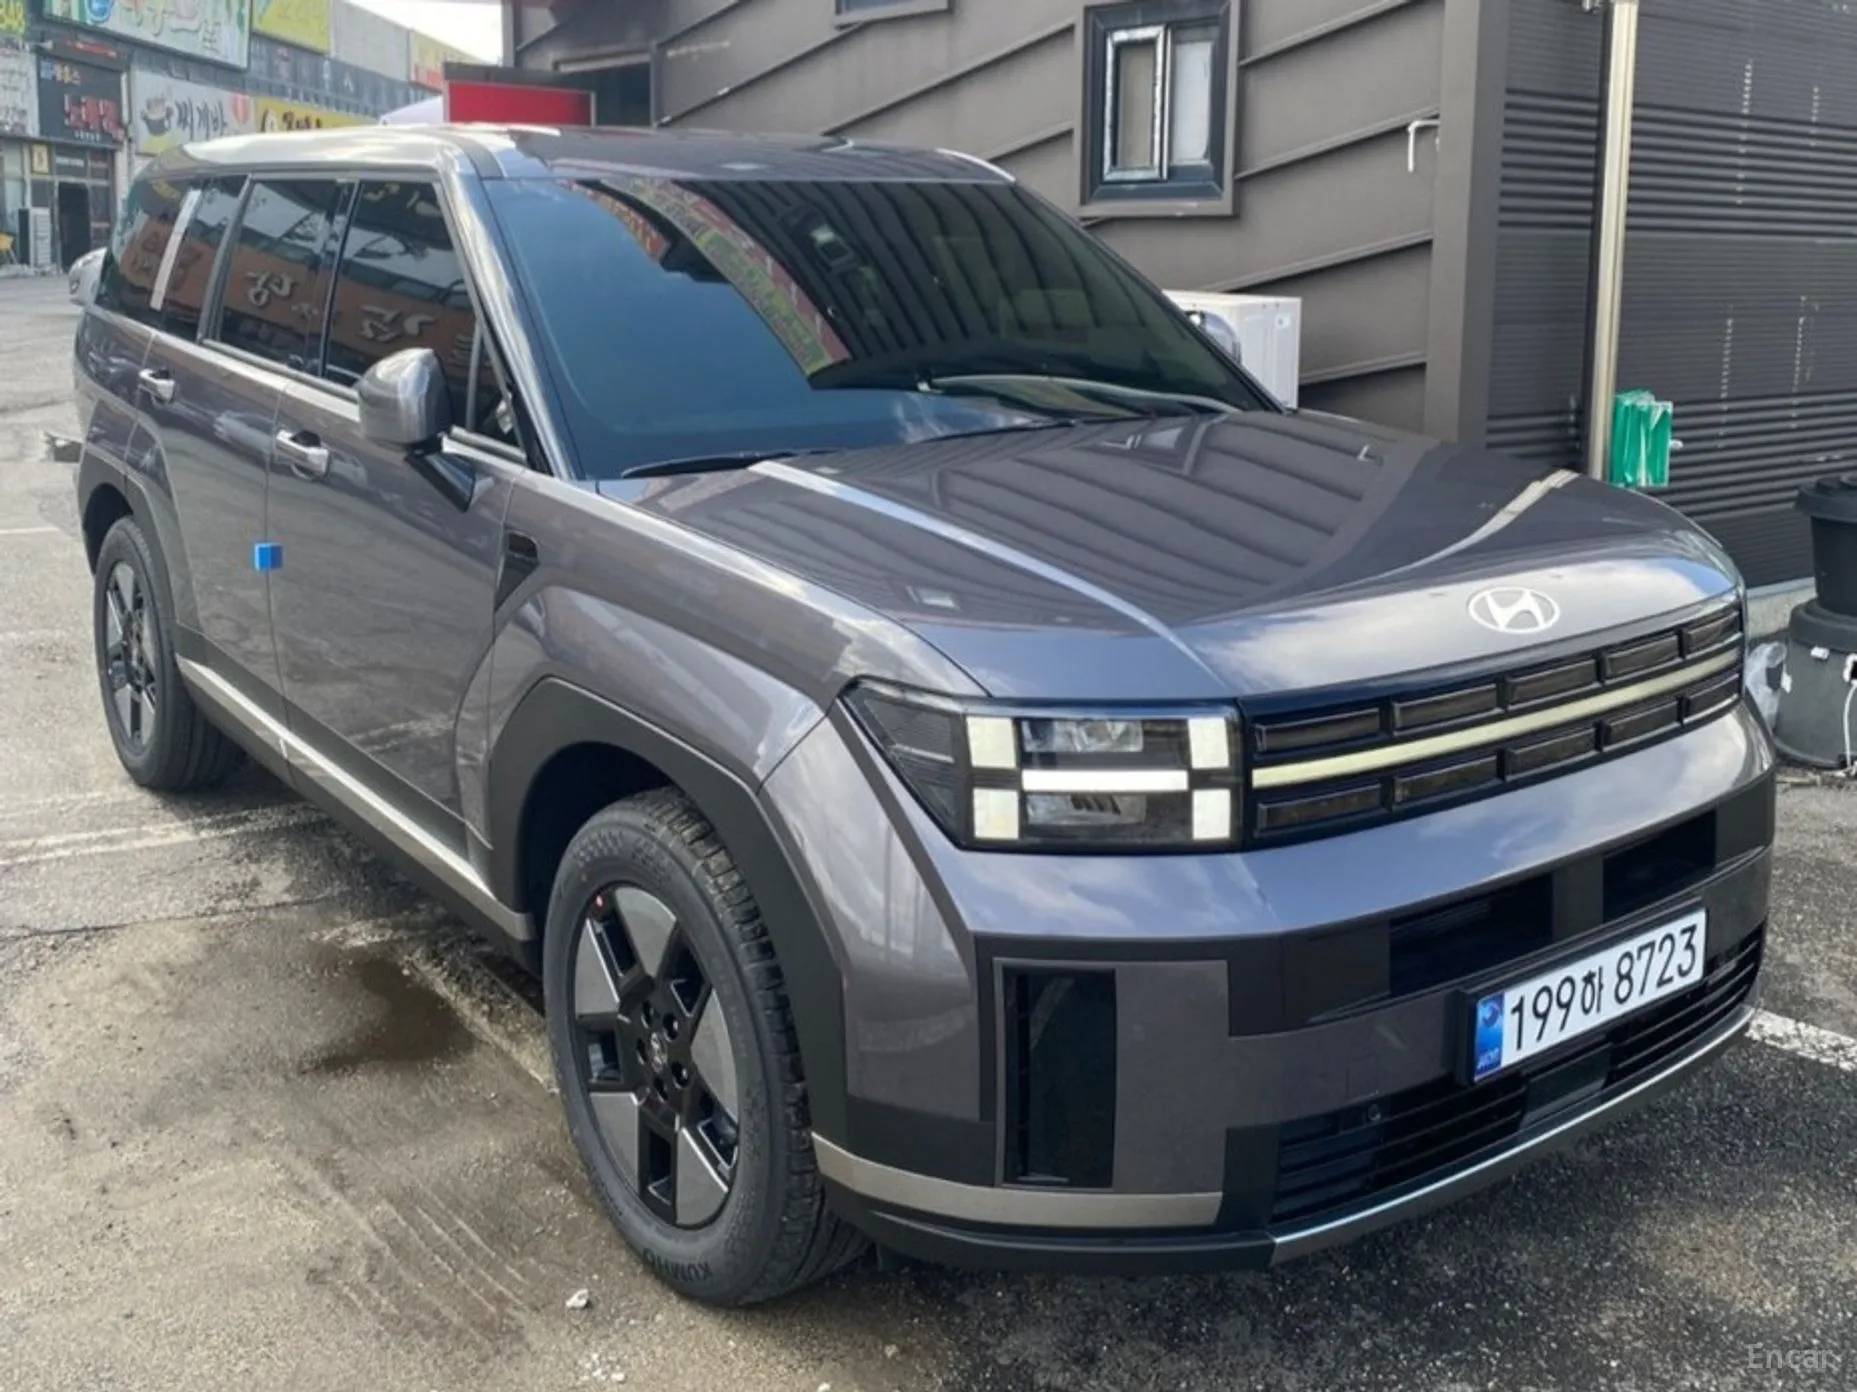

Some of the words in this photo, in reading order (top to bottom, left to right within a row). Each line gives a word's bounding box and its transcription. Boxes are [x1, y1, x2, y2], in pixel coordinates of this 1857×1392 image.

[1510, 966, 1603, 1051] 199하
[1614, 923, 1698, 1005] 8723
[643, 1248, 713, 1283] KUMHO
